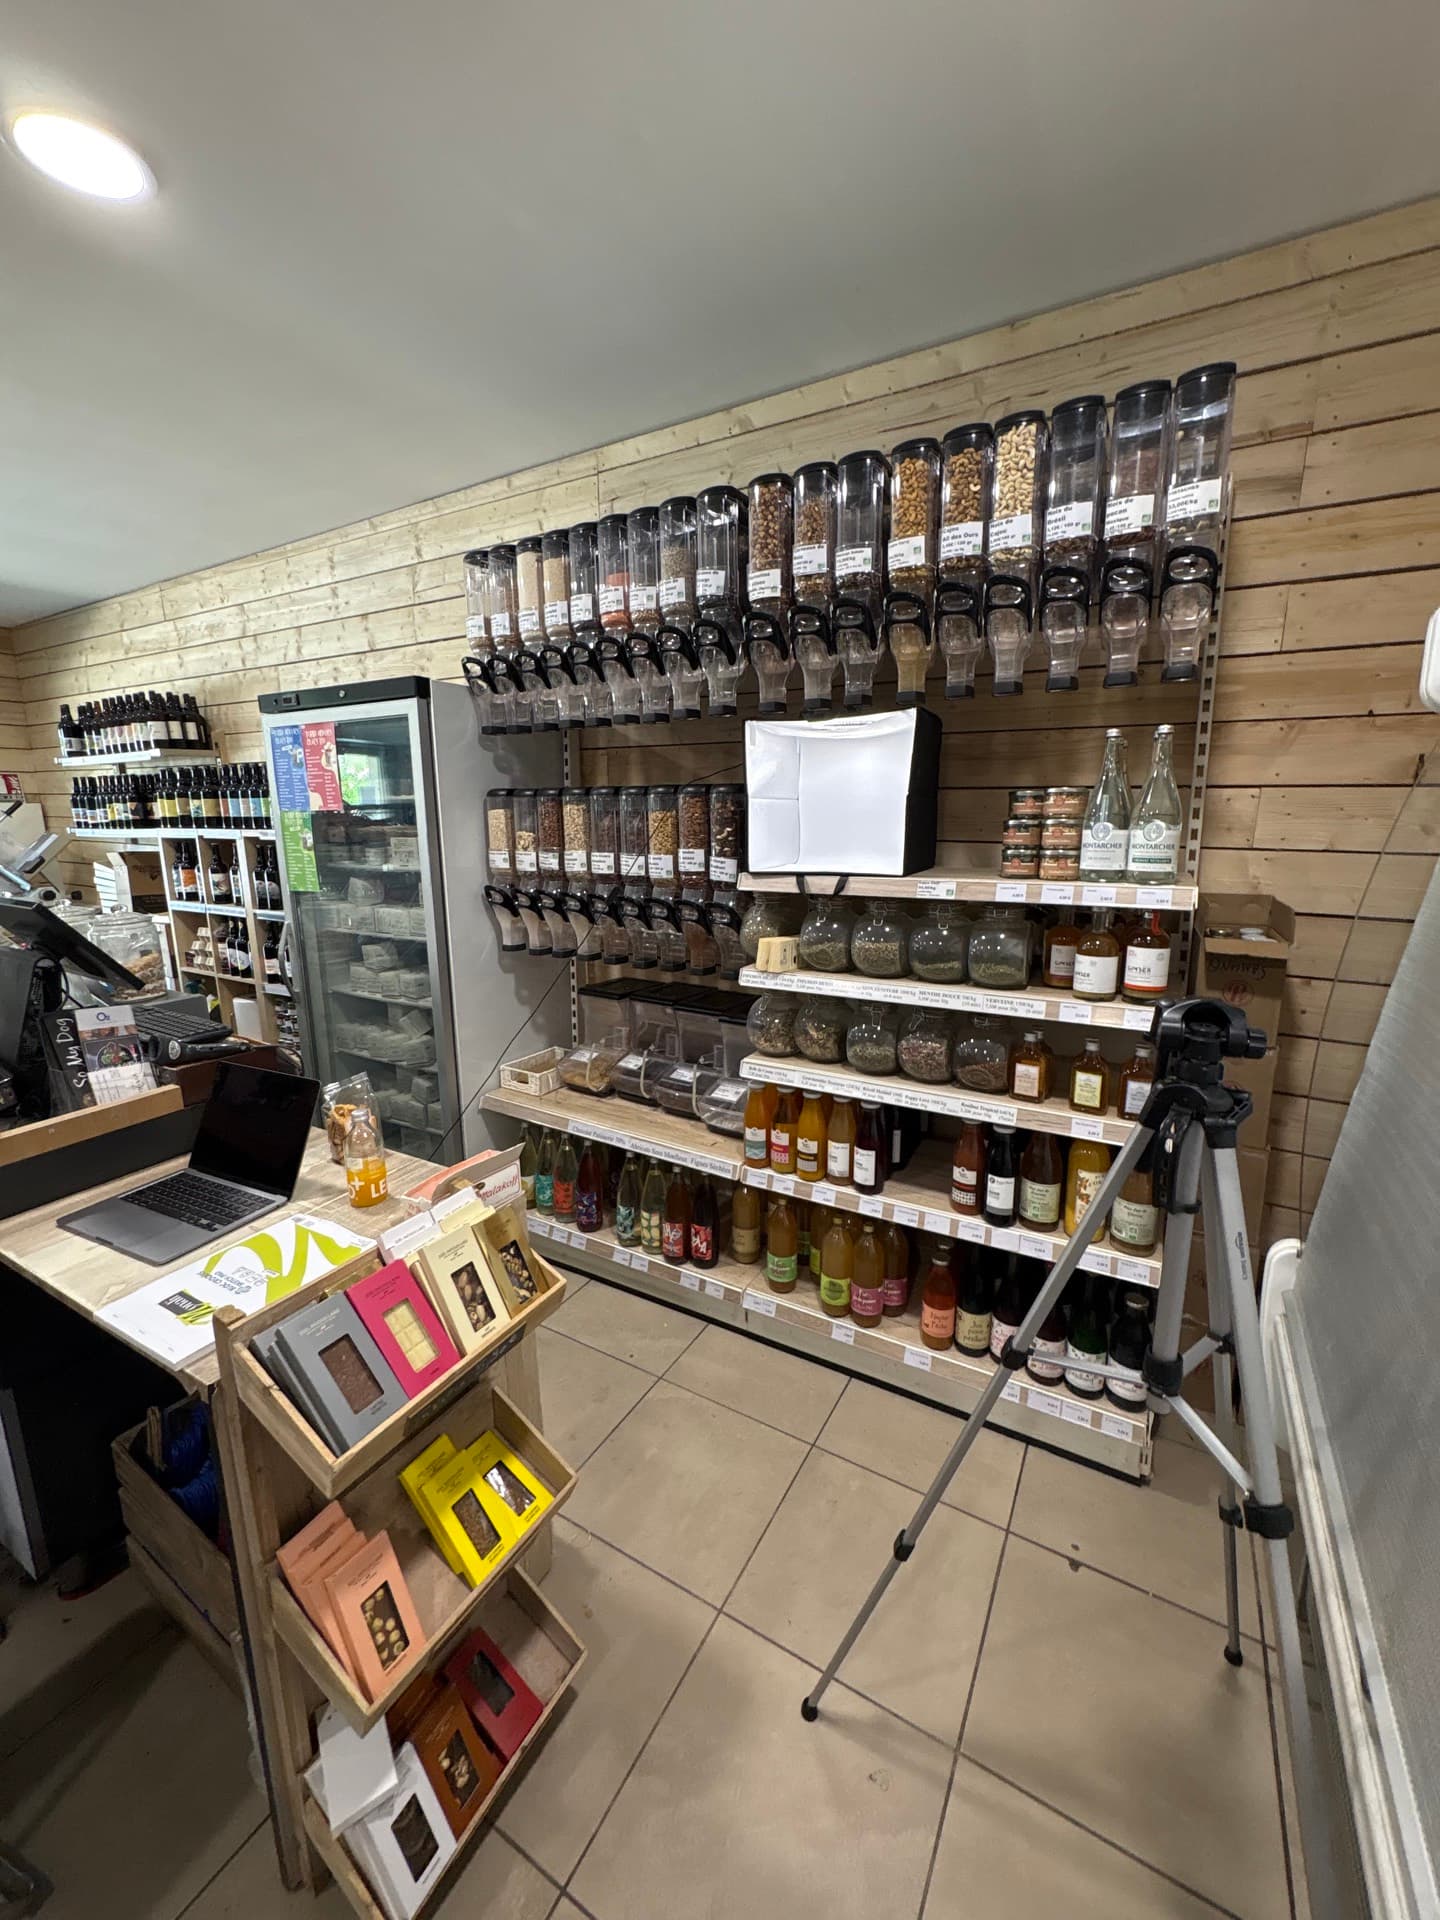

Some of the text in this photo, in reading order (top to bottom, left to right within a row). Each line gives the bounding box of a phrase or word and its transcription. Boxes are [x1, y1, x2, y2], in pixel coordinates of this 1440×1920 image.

[56, 1018, 87, 1088] So My Dog
